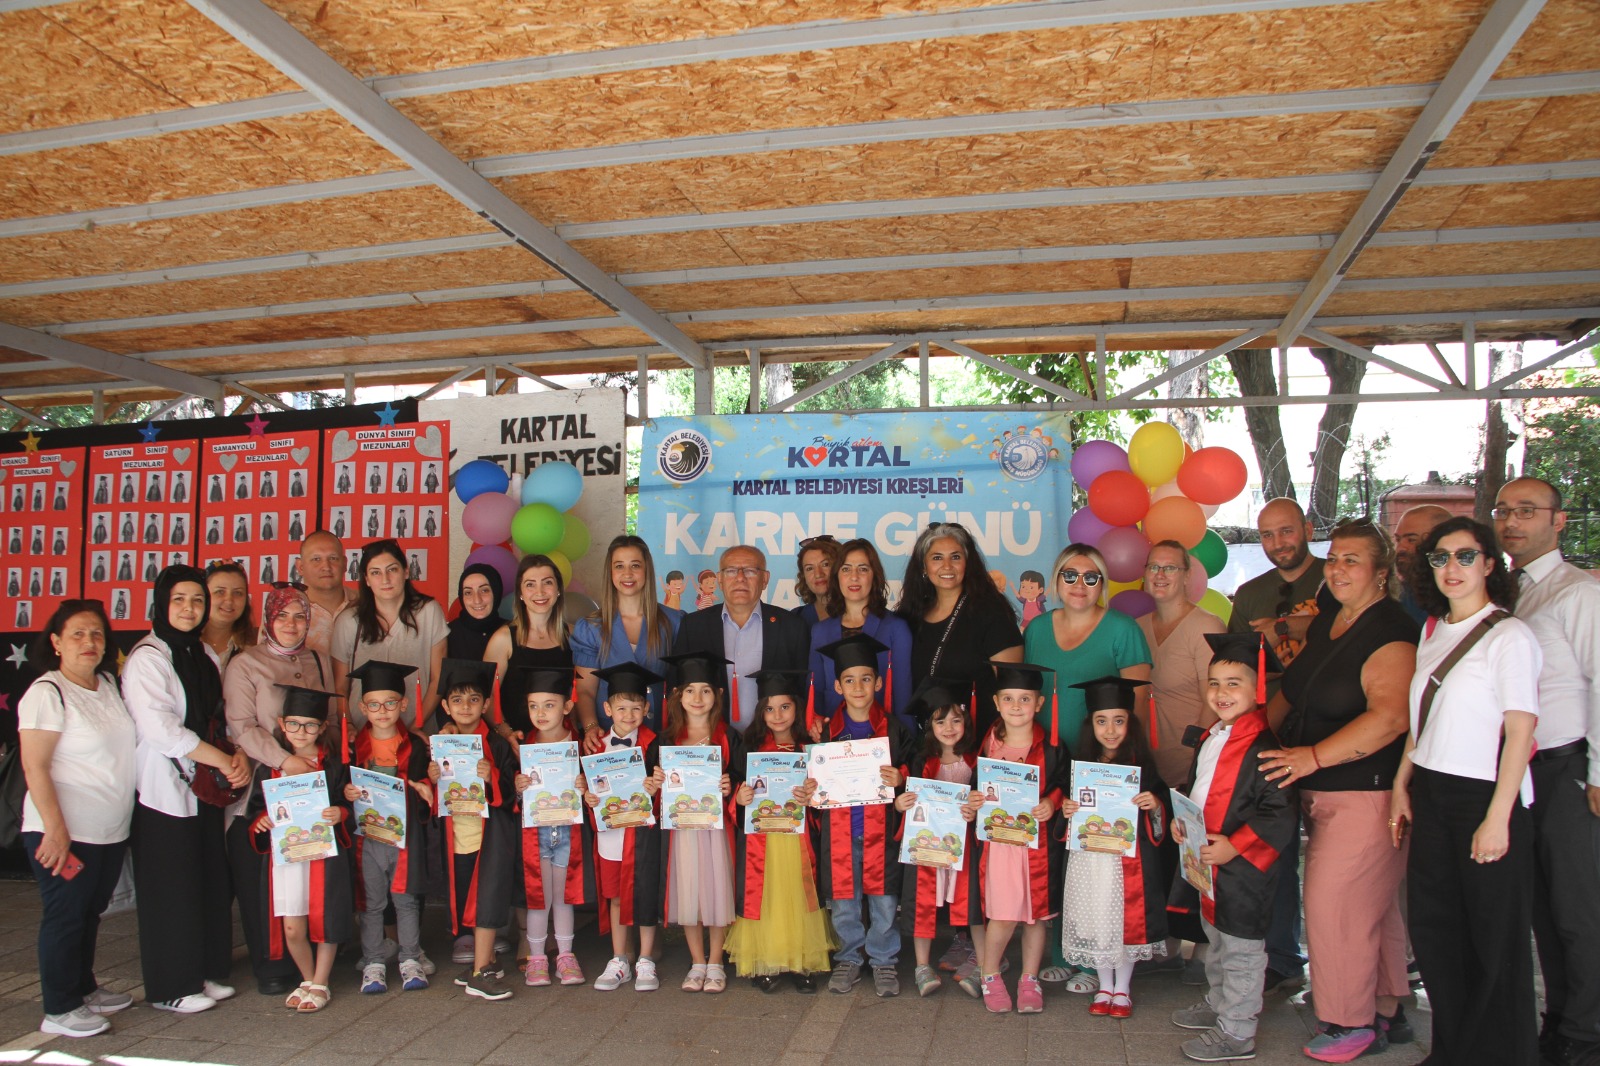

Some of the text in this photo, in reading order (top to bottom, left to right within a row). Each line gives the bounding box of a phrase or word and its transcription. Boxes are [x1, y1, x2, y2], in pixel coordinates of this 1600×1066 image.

[358, 430, 385, 439] DÜNYA
[501, 414, 595, 444] KARTAL
[213, 443, 255, 452] SAMANYOLU
[363, 441, 409, 449] MEZUNLARI
[660, 432, 710, 456] KARTAL BELEDİYESİ
[478, 442, 621, 480] ELEYESİ
[788, 446, 910, 468] KRTAL
[733, 478, 964, 498] KARTAL BELEDİYESİ KREŞLERİ
[664, 502, 1042, 556] KARNE GÜNÜ
